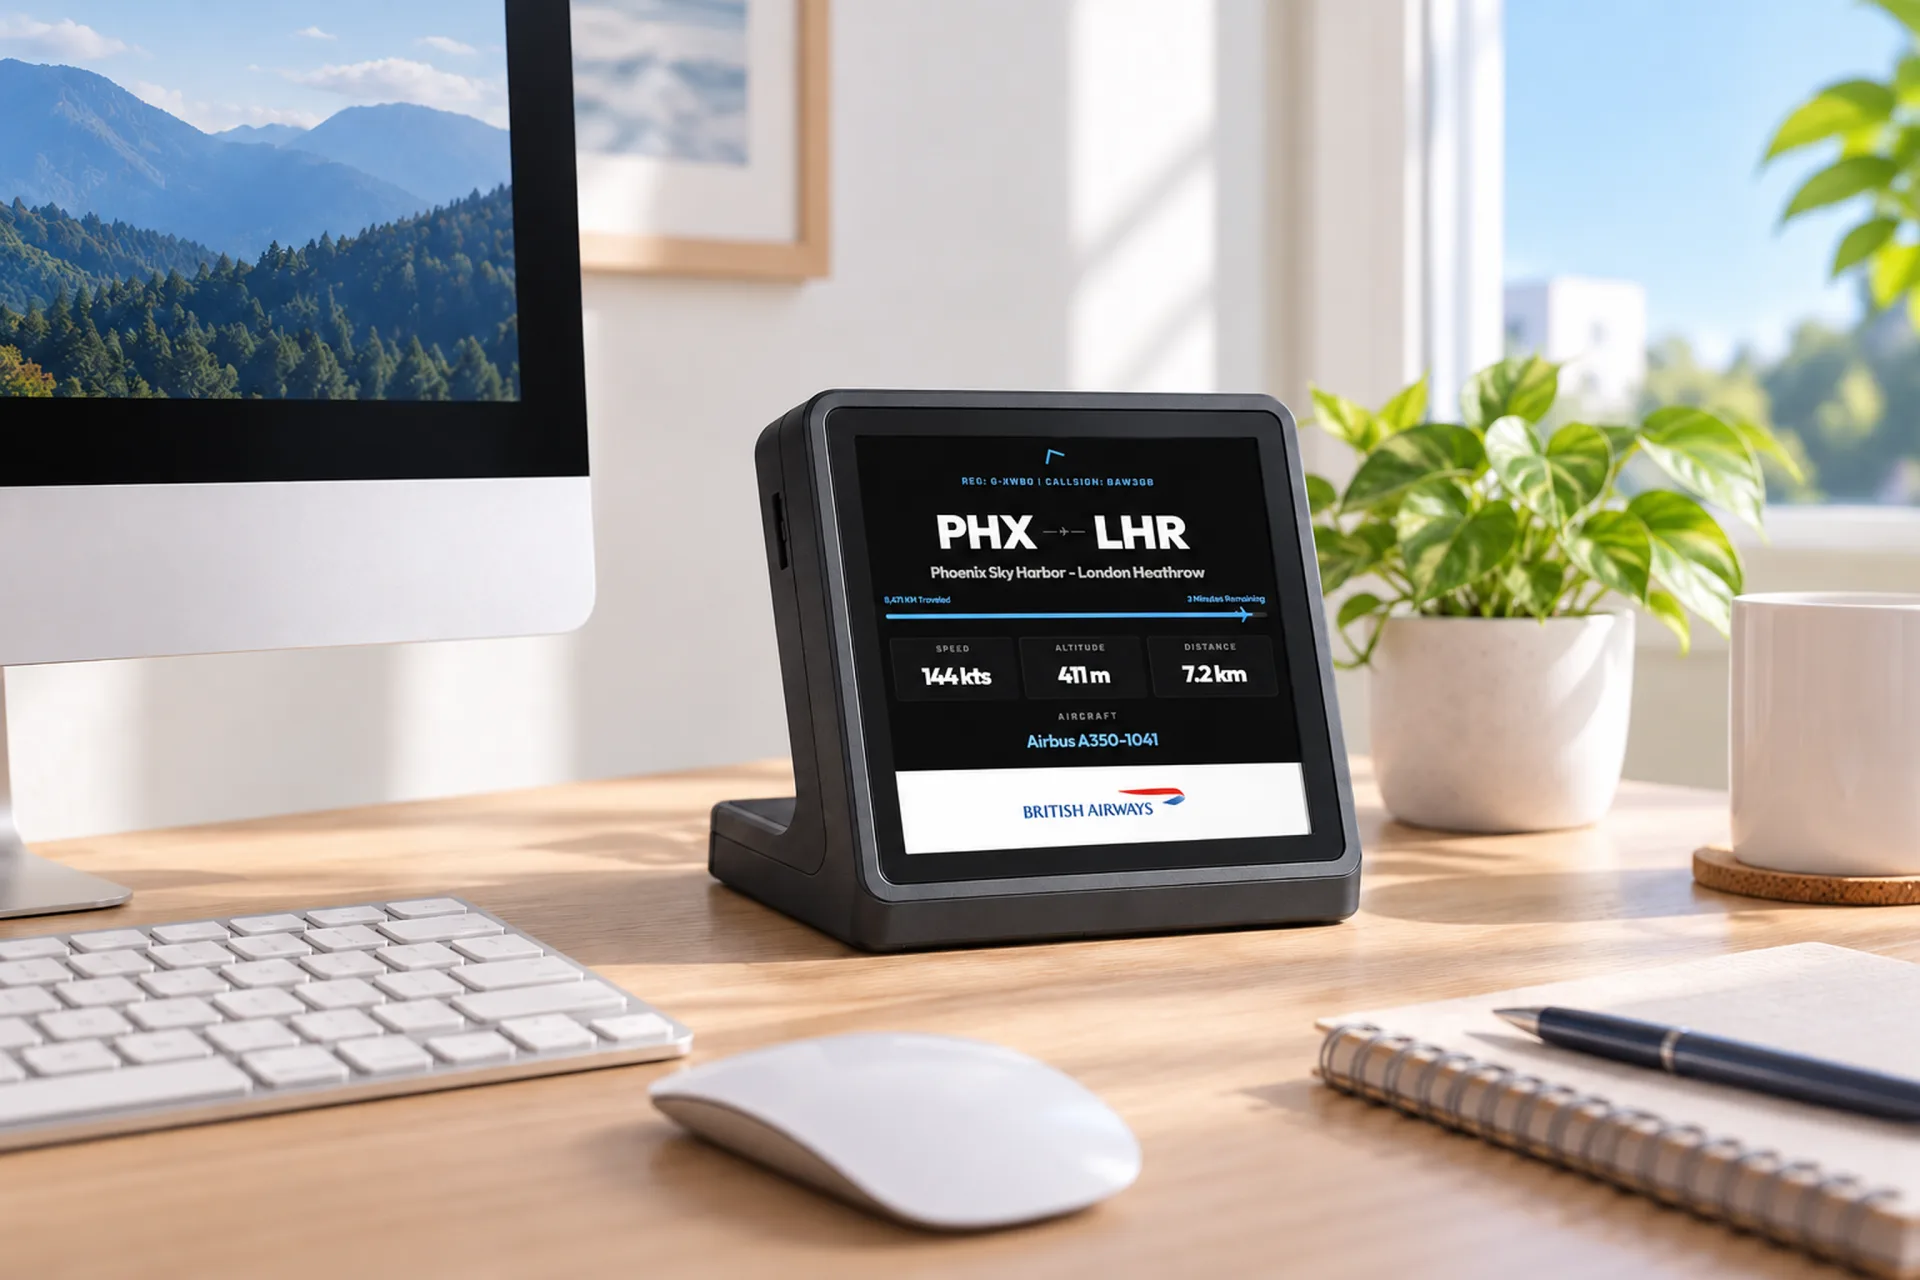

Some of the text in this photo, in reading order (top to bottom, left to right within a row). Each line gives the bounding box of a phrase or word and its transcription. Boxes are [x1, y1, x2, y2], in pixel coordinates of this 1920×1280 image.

[936, 514, 1190, 550] PHX LHR
[930, 565, 987, 580] Phoenix
[988, 565, 1014, 582] Sky
[1015, 565, 1066, 580] Harbor
[1077, 565, 1131, 580] London
[1132, 565, 1205, 580] Heathrow
[918, 596, 952, 605] Traveled
[1224, 595, 1266, 605] Remaining
[935, 644, 970, 654] SPEED
[1055, 643, 1106, 652] ALTITUDE
[1184, 642, 1237, 651] DISTANCE
[921, 666, 993, 686] 144 kts
[1090, 670, 1111, 684] m
[1181, 664, 1248, 683] 7.2 km
[1058, 711, 1118, 721] AIRCRAFT
[1026, 732, 1159, 749] Airbus A350-1041
[1023, 802, 1154, 819] BRITISH AIRWAYS
